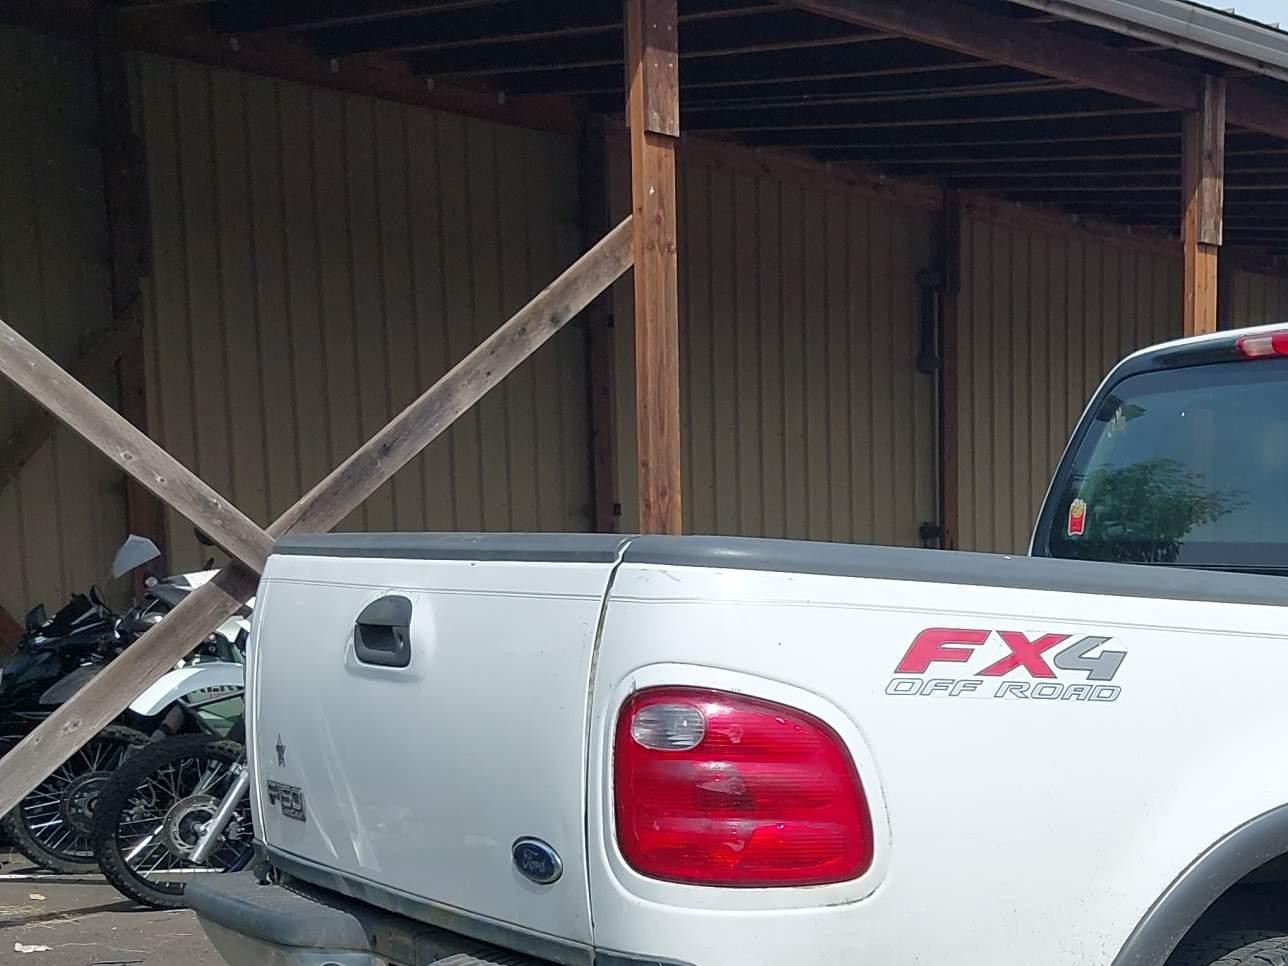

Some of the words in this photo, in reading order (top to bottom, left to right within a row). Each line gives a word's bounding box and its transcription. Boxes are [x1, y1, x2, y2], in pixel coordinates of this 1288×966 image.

[894, 627, 1127, 681] FX4
[885, 677, 983, 697] OFF
[993, 680, 1122, 702] ROAD
